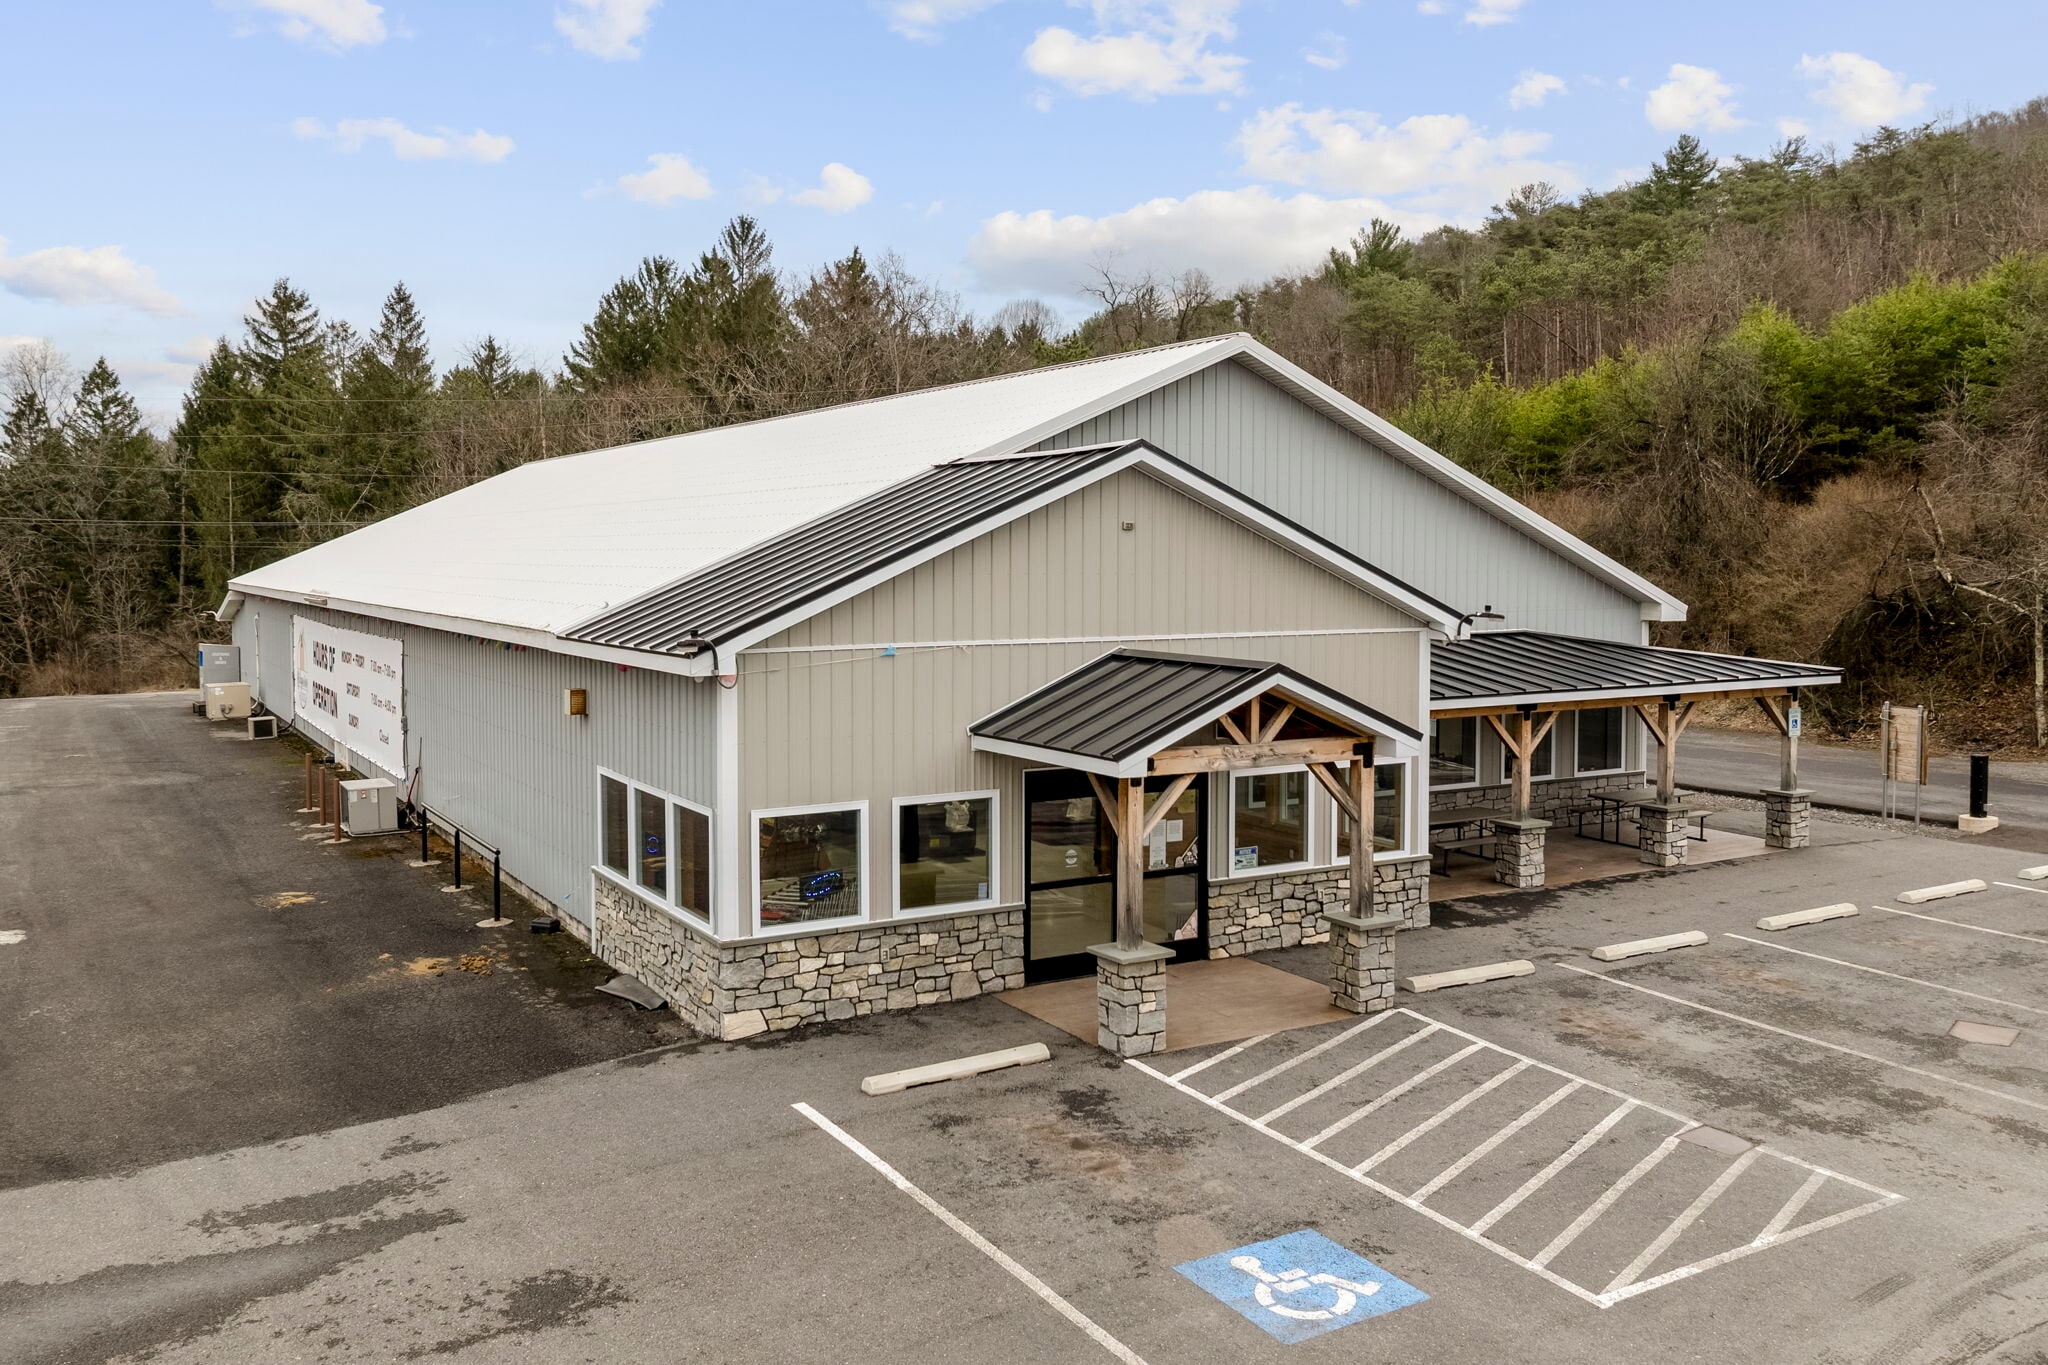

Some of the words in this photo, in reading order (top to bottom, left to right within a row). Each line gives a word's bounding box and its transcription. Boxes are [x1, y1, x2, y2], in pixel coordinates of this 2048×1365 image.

[312, 641, 328, 670] HOURS
[329, 646, 335, 672] OF
[312, 680, 338, 719] OPERATION
